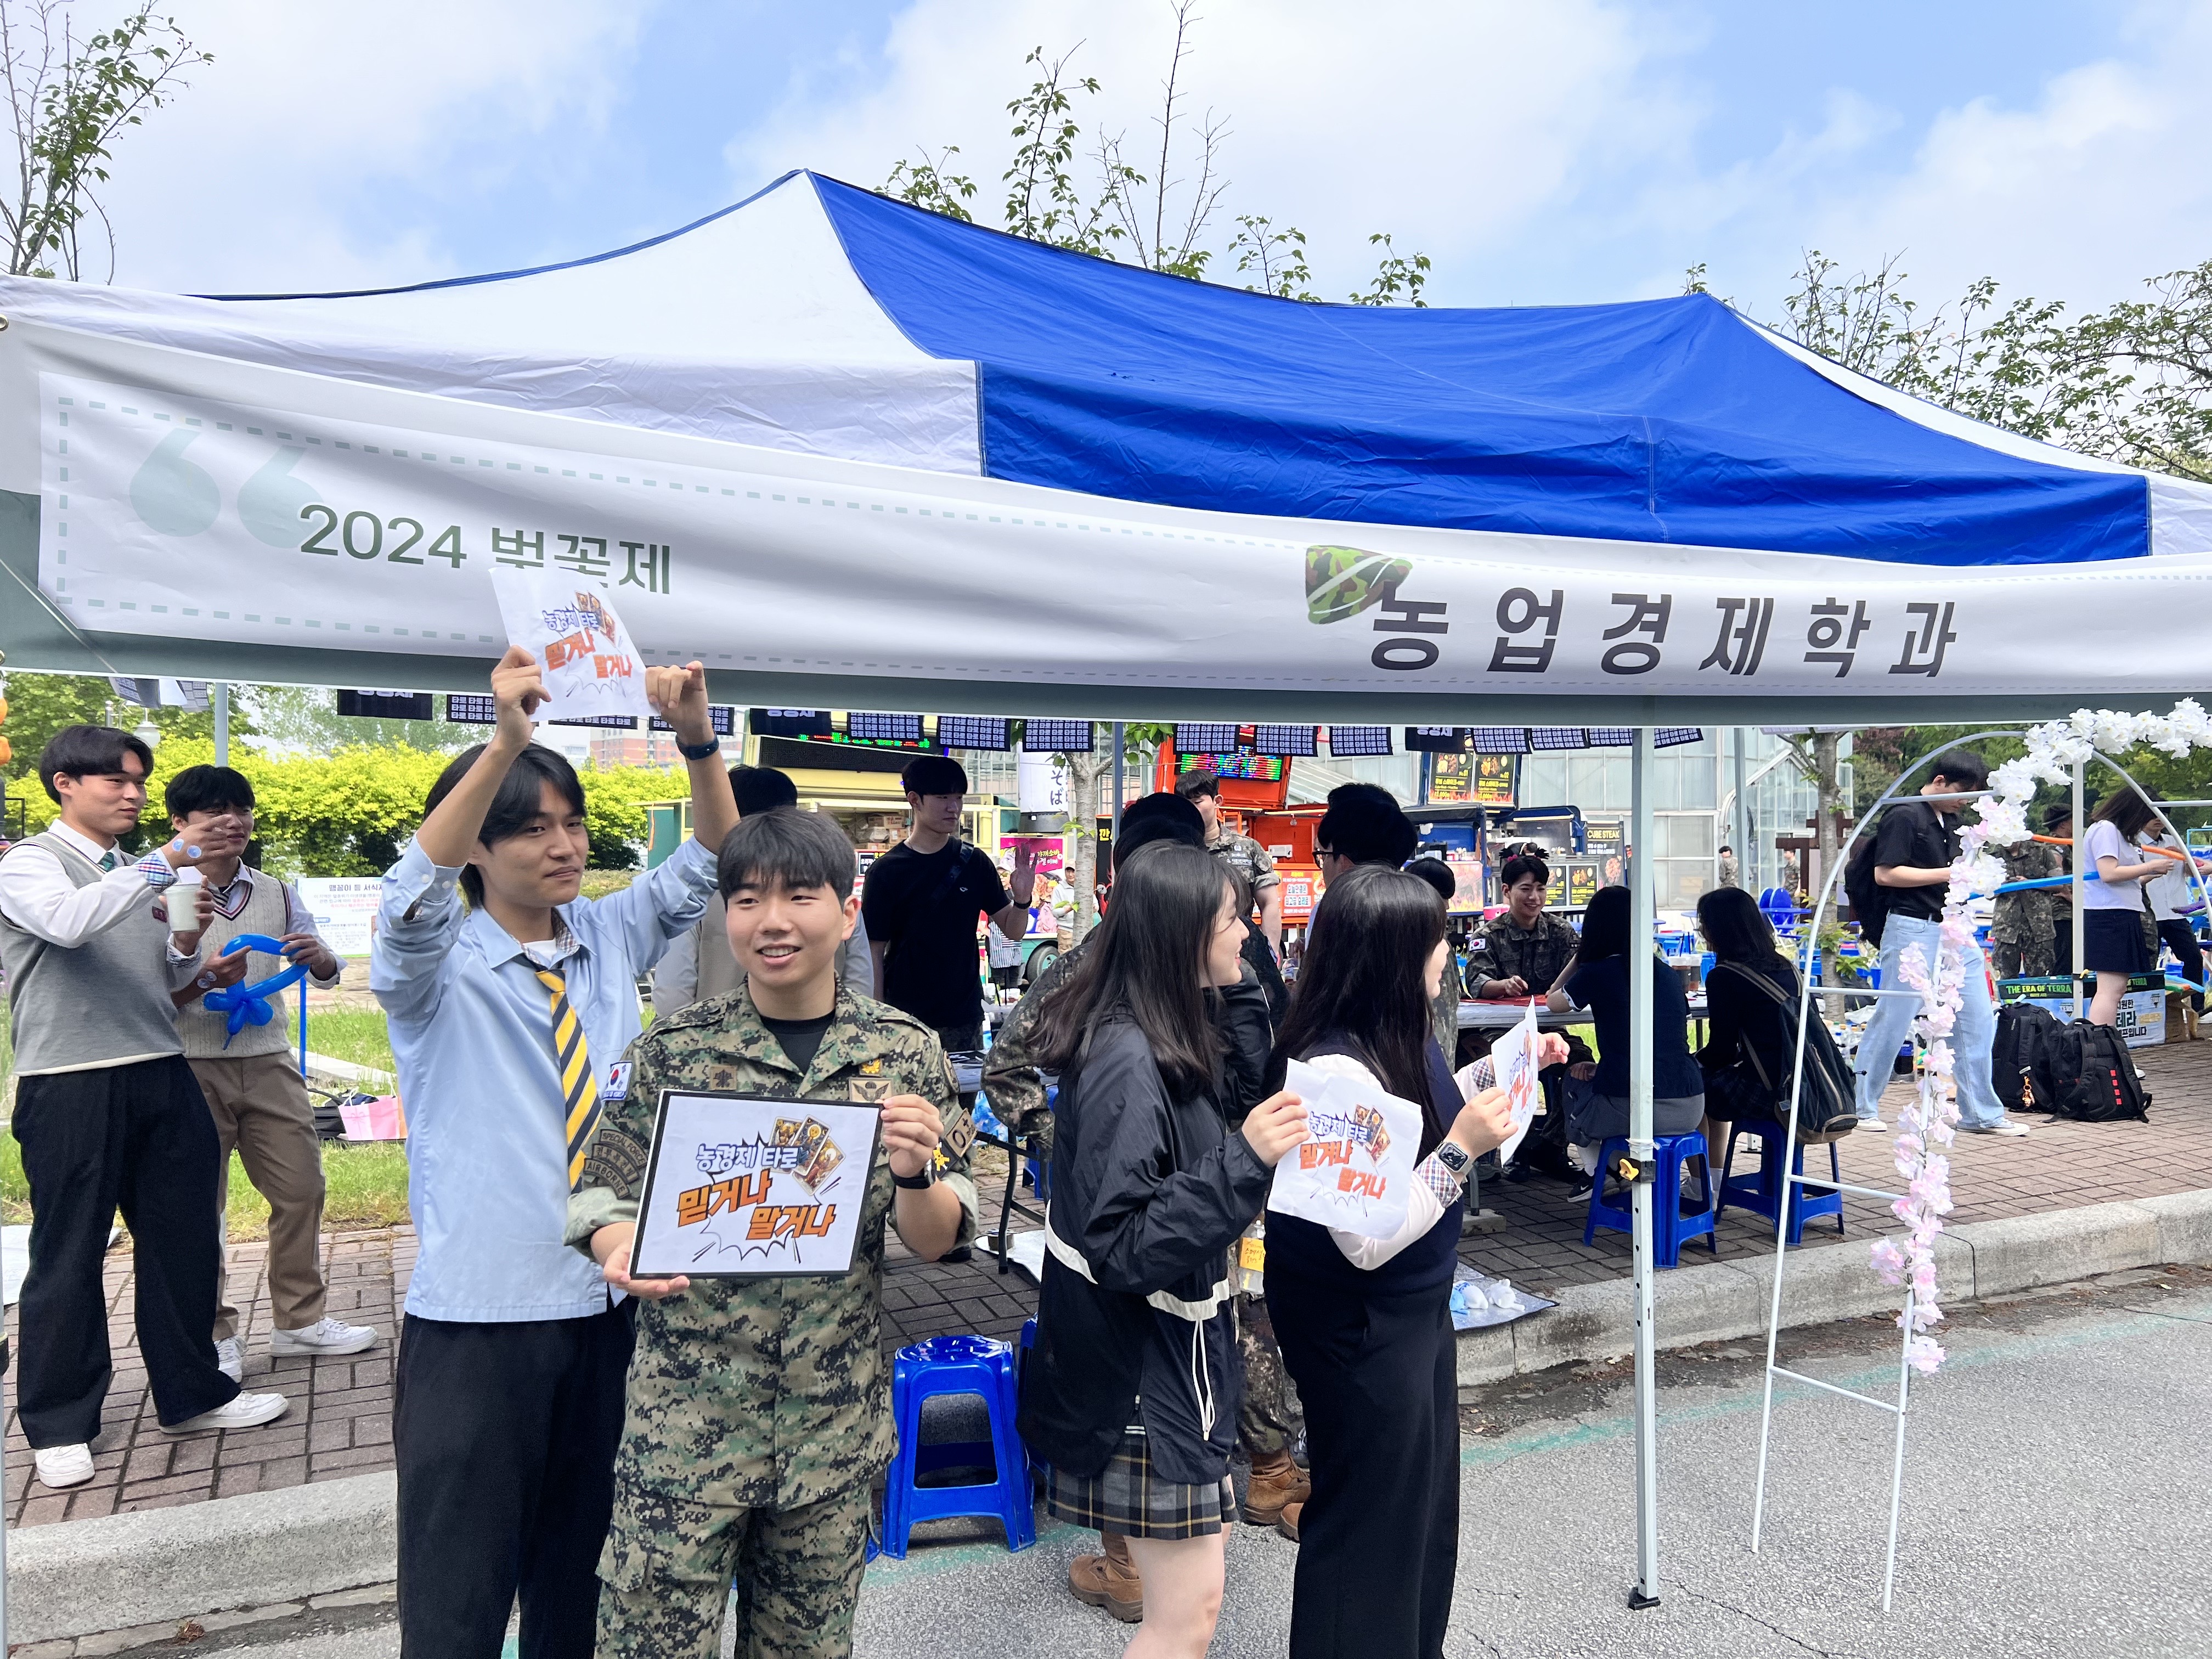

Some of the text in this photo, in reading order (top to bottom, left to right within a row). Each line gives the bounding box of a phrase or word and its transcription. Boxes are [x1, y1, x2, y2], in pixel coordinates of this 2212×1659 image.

[299, 504, 467, 569] 2024
[542, 610, 599, 631] 농경제 타로
[1369, 579, 1957, 678] 농업경제학과
[1099, 828, 1113, 841] 깐
[1587, 830, 1620, 839] CUBE STEAK
[2006, 984, 2072, 994] THE ERA OF TERRA
[2118, 1026, 2147, 1038] 프입니다
[1308, 1110, 1368, 1143] 농경제 타로
[628, 1140, 646, 1164] FORCE
[696, 1143, 799, 1171] 농경제 타로
[586, 1161, 626, 1194] AIRBORNE
[676, 1168, 774, 1227] 믿거나
[746, 1203, 837, 1240] 말거나
